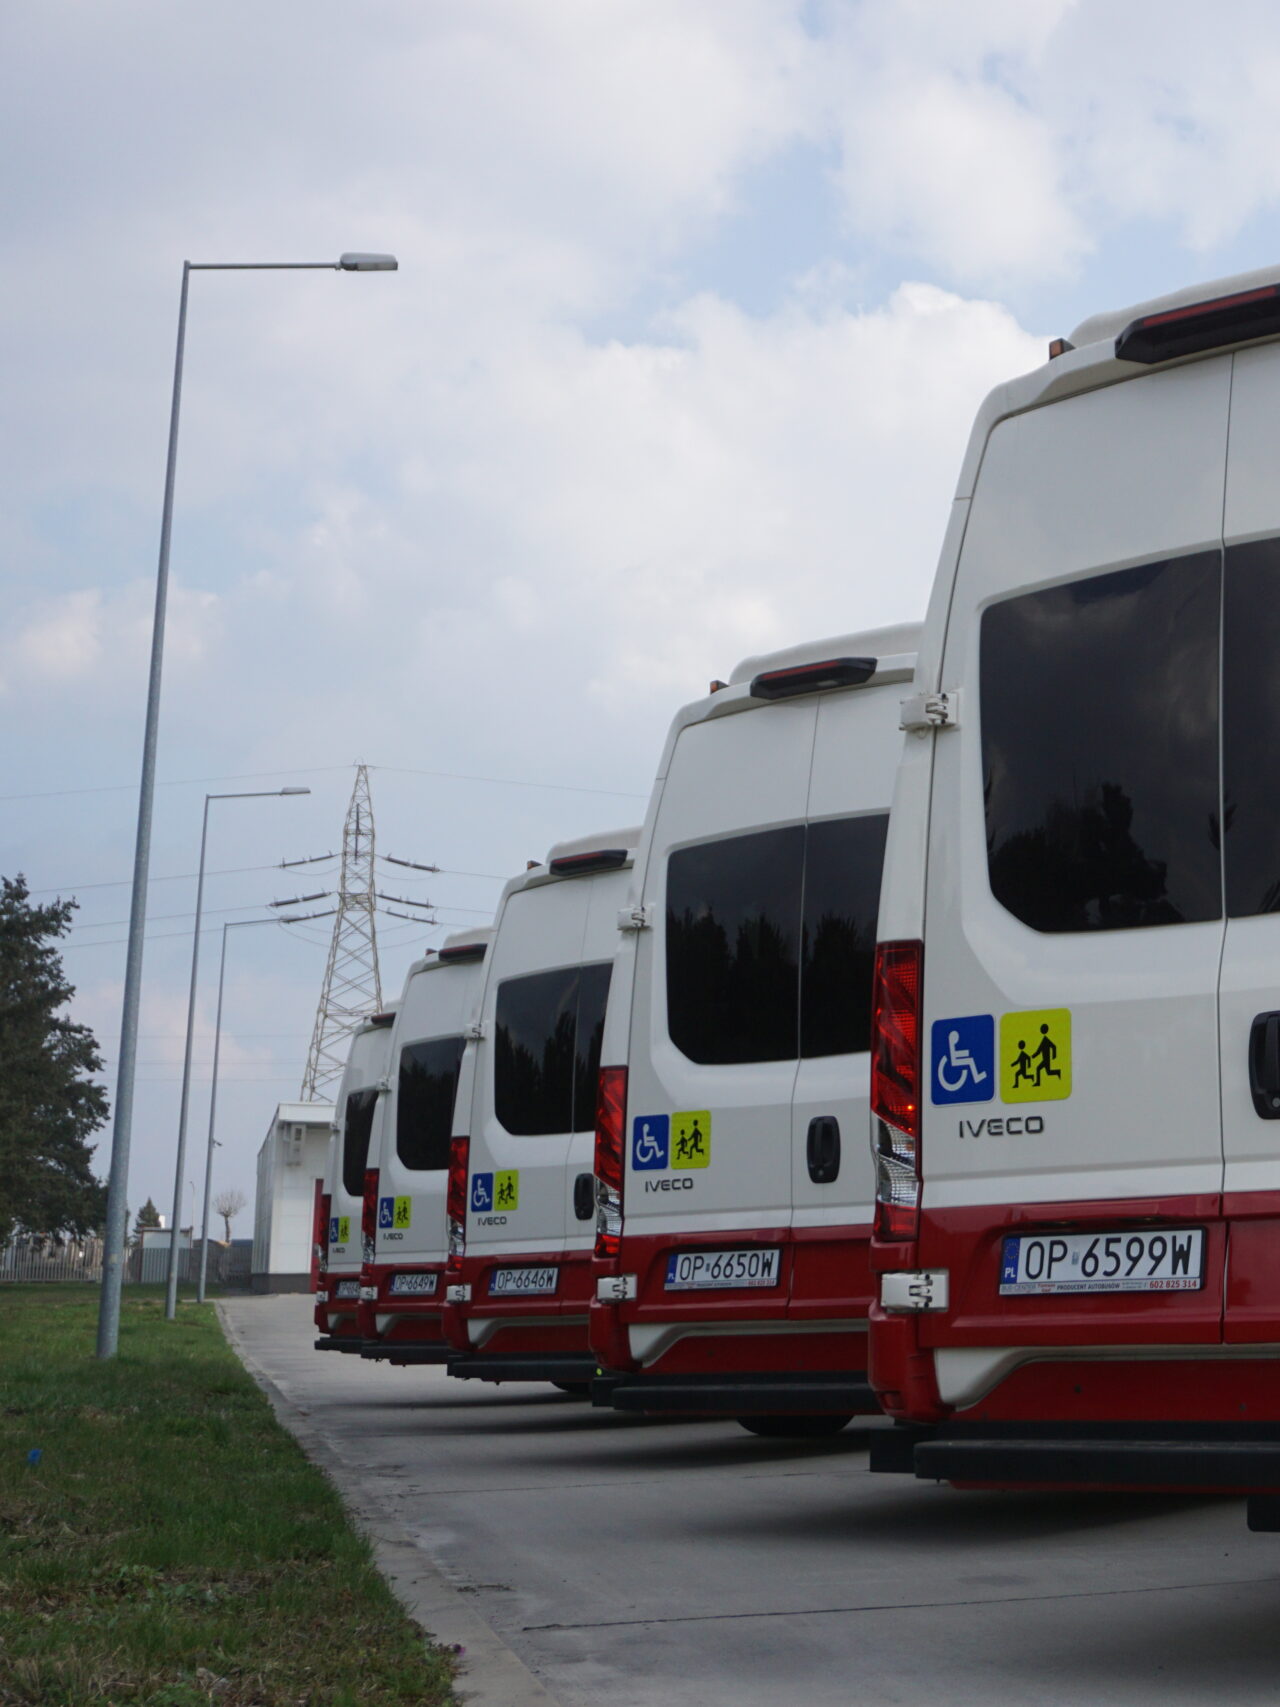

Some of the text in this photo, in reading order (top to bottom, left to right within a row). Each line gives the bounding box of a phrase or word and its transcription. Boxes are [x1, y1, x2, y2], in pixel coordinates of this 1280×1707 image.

[959, 1115, 1044, 1138] IVECO
[645, 1177, 693, 1193] IVECO
[477, 1216, 507, 1226] IVECO
[383, 1232, 404, 1240] IVECO
[1025, 1234, 1193, 1280] OP 6599W
[680, 1252, 774, 1281] OP 6650W
[1004, 1267, 1016, 1279] PL
[497, 1269, 555, 1289] OP 6646W
[1150, 1281, 1164, 1289] 602
[1165, 1280, 1181, 1288] 825
[1182, 1280, 1197, 1288] 314
